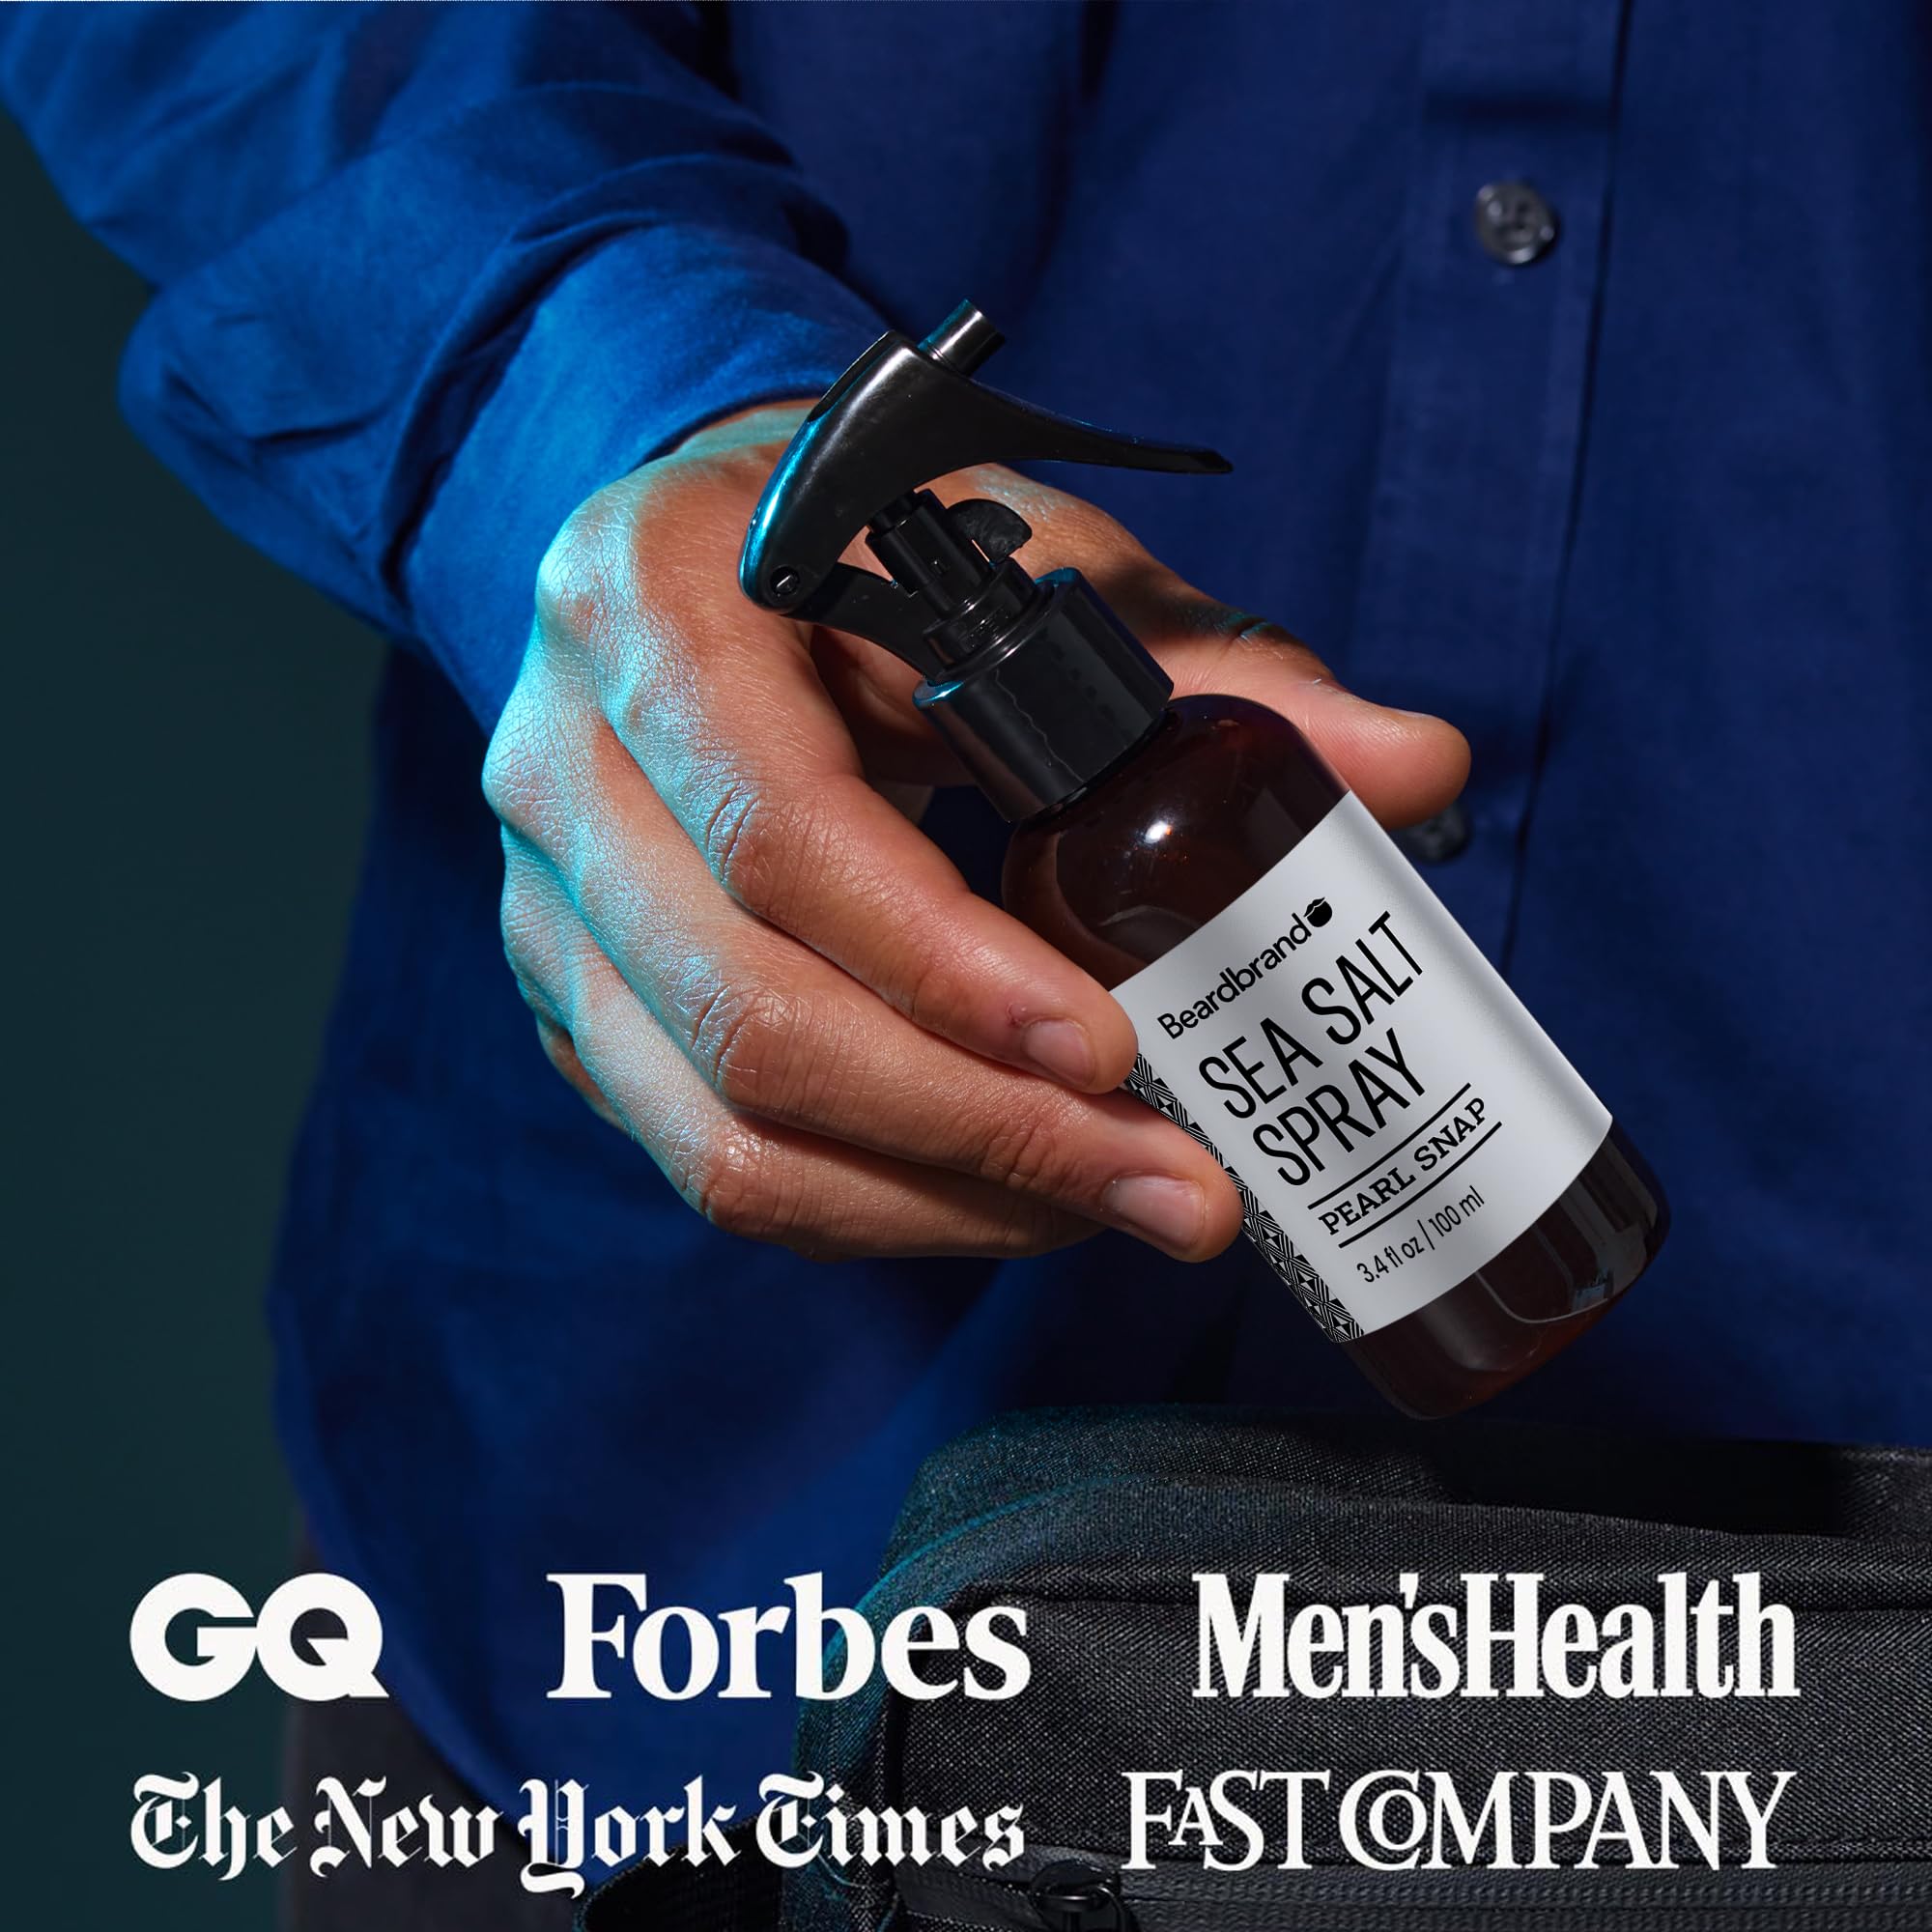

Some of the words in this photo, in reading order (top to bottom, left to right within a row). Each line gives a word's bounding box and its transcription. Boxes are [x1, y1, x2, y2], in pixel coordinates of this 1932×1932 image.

[1156, 911, 1314, 1040] Beardbrand
[1198, 1016, 1324, 1120] SEA
[1300, 910, 1424, 1045] SALT
[1252, 1027, 1427, 1186] SPRAY
[1318, 1166, 1417, 1236] PEARL
[1413, 1096, 1487, 1172] SNAP
[1356, 1254, 1390, 1283] 3.4
[1383, 1245, 1404, 1268] fl
[1401, 1236, 1425, 1259] oz
[1427, 1205, 1462, 1237] 100
[1458, 1184, 1485, 1217] ml
